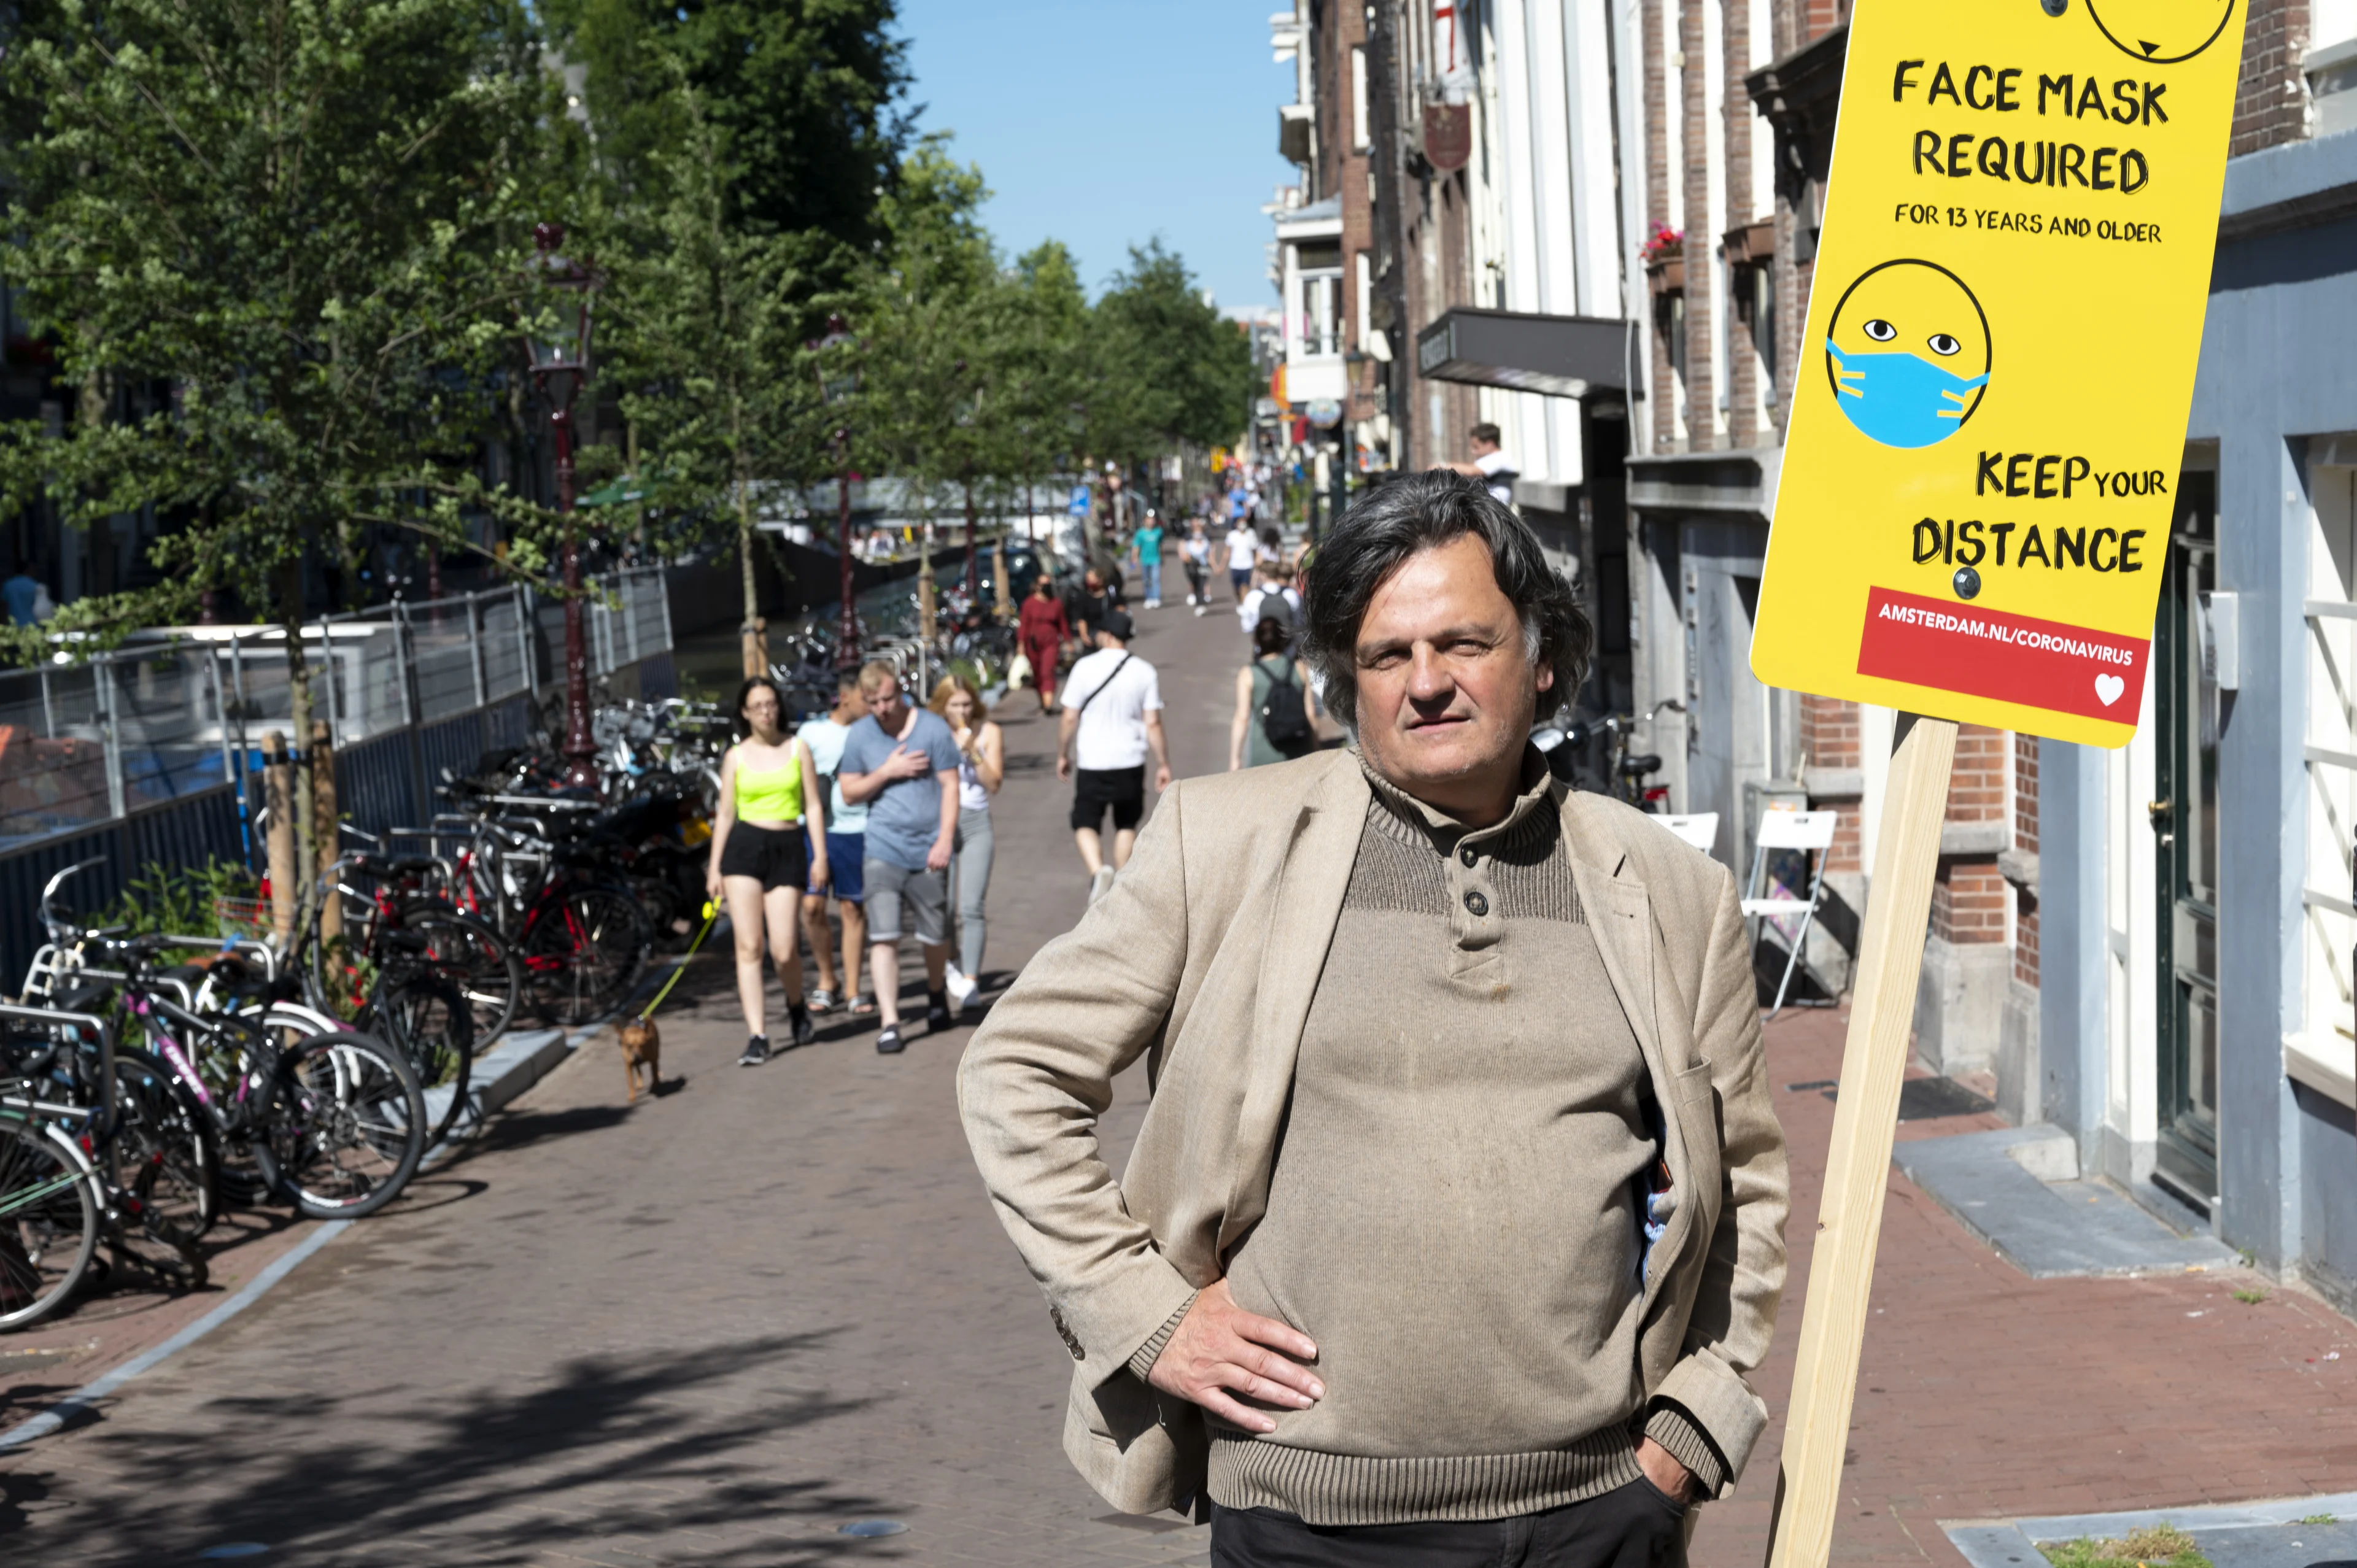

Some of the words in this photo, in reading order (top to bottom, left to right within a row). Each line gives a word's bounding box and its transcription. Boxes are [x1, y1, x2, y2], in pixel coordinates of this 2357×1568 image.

[1893, 60, 2023, 112] FACE
[2038, 73, 2169, 126] MASK
[1913, 130, 2149, 194] REQUIRED
[1895, 203, 1939, 224] FOR
[1946, 207, 1967, 227] 13
[1975, 210, 2043, 233] YEARS
[2049, 217, 2091, 238] AND
[2097, 220, 2162, 243] OLDER
[1976, 450, 2091, 499] KEEP
[2094, 470, 2167, 497] YOUR
[1913, 517, 2146, 573] DISTANCE
[1878, 603, 2133, 666] AMSTERDAM.NL/CORONAVIRUS
